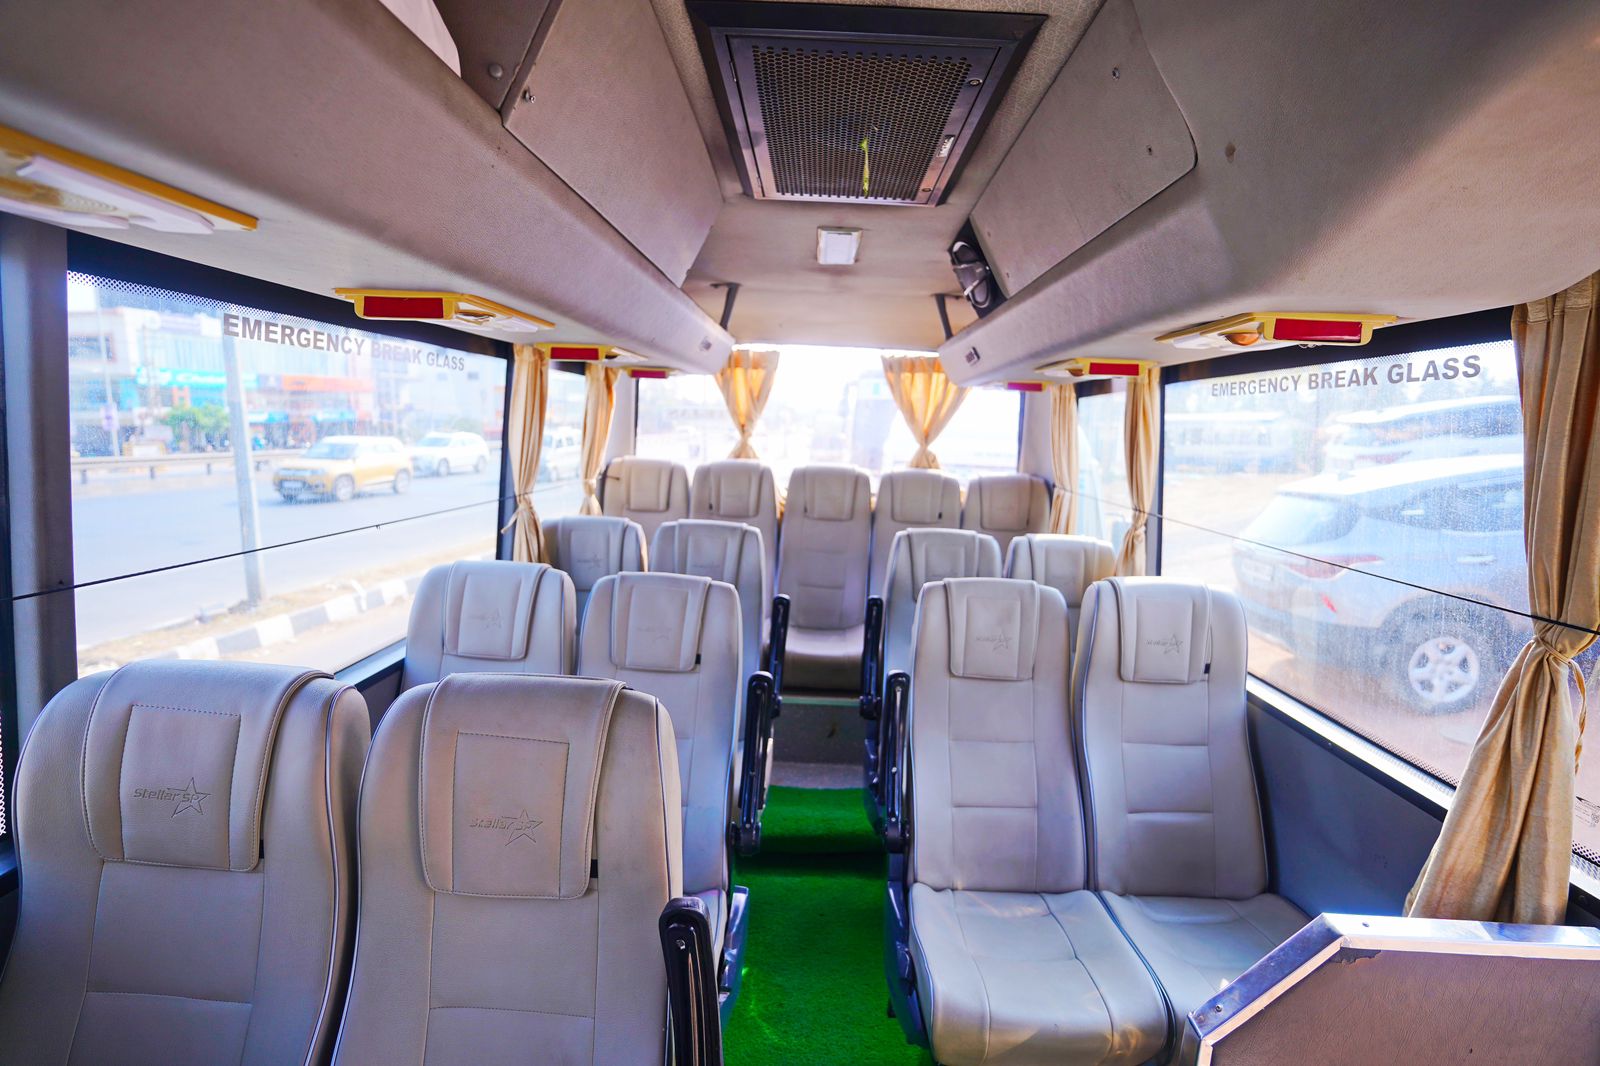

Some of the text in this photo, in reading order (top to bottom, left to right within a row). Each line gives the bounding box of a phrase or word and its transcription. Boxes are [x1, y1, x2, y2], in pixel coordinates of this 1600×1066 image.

[224, 312, 465, 371] EMERGENCY BREAK GLASS
[1211, 354, 1481, 397] EMERGENCY BREAK GLASS
[133, 787, 180, 801] Stellar
